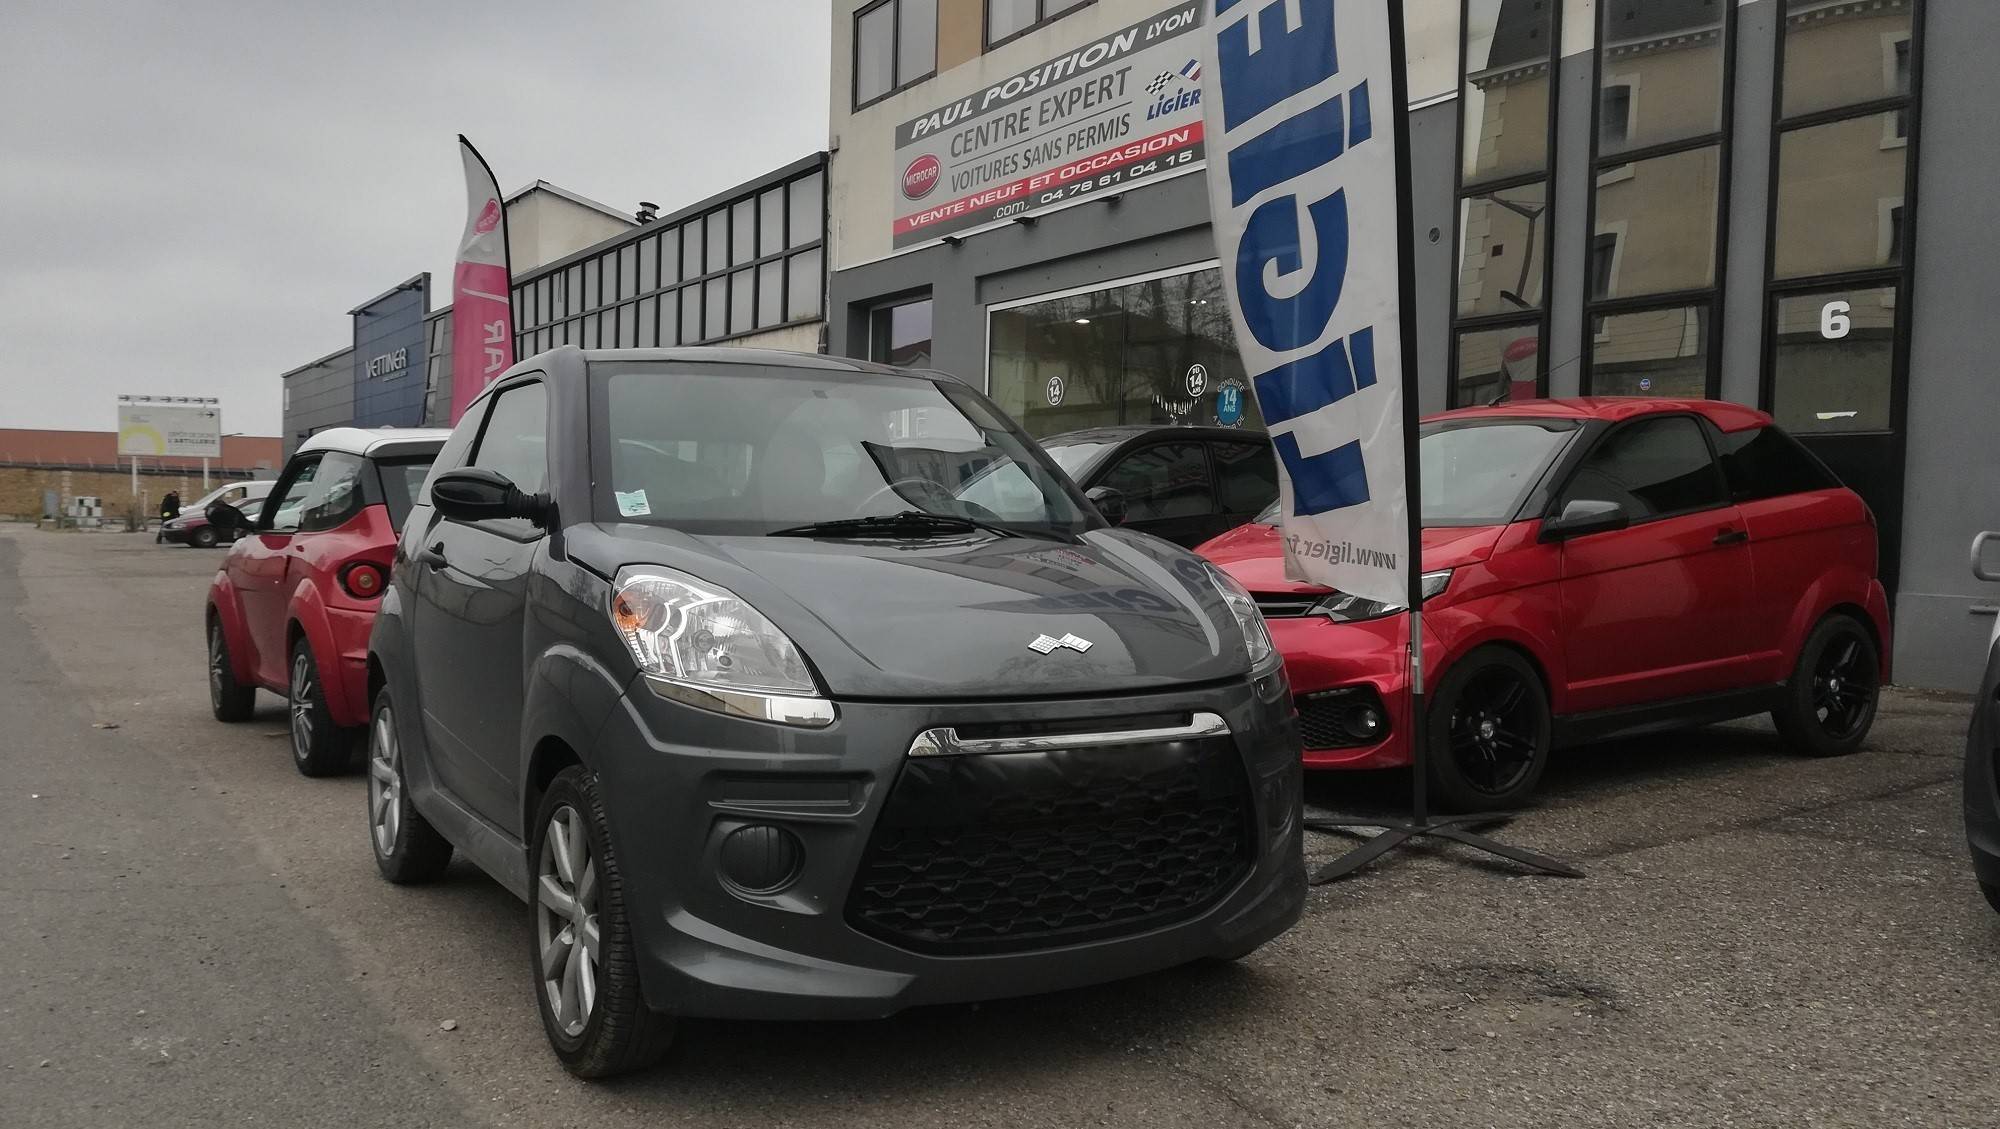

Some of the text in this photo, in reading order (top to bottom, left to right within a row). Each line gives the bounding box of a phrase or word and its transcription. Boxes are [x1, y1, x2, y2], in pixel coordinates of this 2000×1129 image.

[911, 7, 1196, 139] PAUL POSITION LYON
[950, 66, 1132, 158] CENTRE EXPERT
[951, 113, 1130, 192] VOITURES SANS PERMIS
[906, 165, 937, 187] MICROCAR
[909, 129, 1190, 227] VENTE NEUF ET OCCASION
[1040, 188, 1064, 204] 04
[1069, 180, 1093, 196] 78
[1129, 160, 1157, 177] 04
[1165, 150, 1193, 166] 15
[1820, 302, 1851, 339] 6
[365, 347, 408, 378] VETTINER
[1049, 384, 1061, 398] 14
[1189, 373, 1203, 388] 14
[1223, 388, 1237, 405] 14
[1223, 404, 1236, 413] ANS
